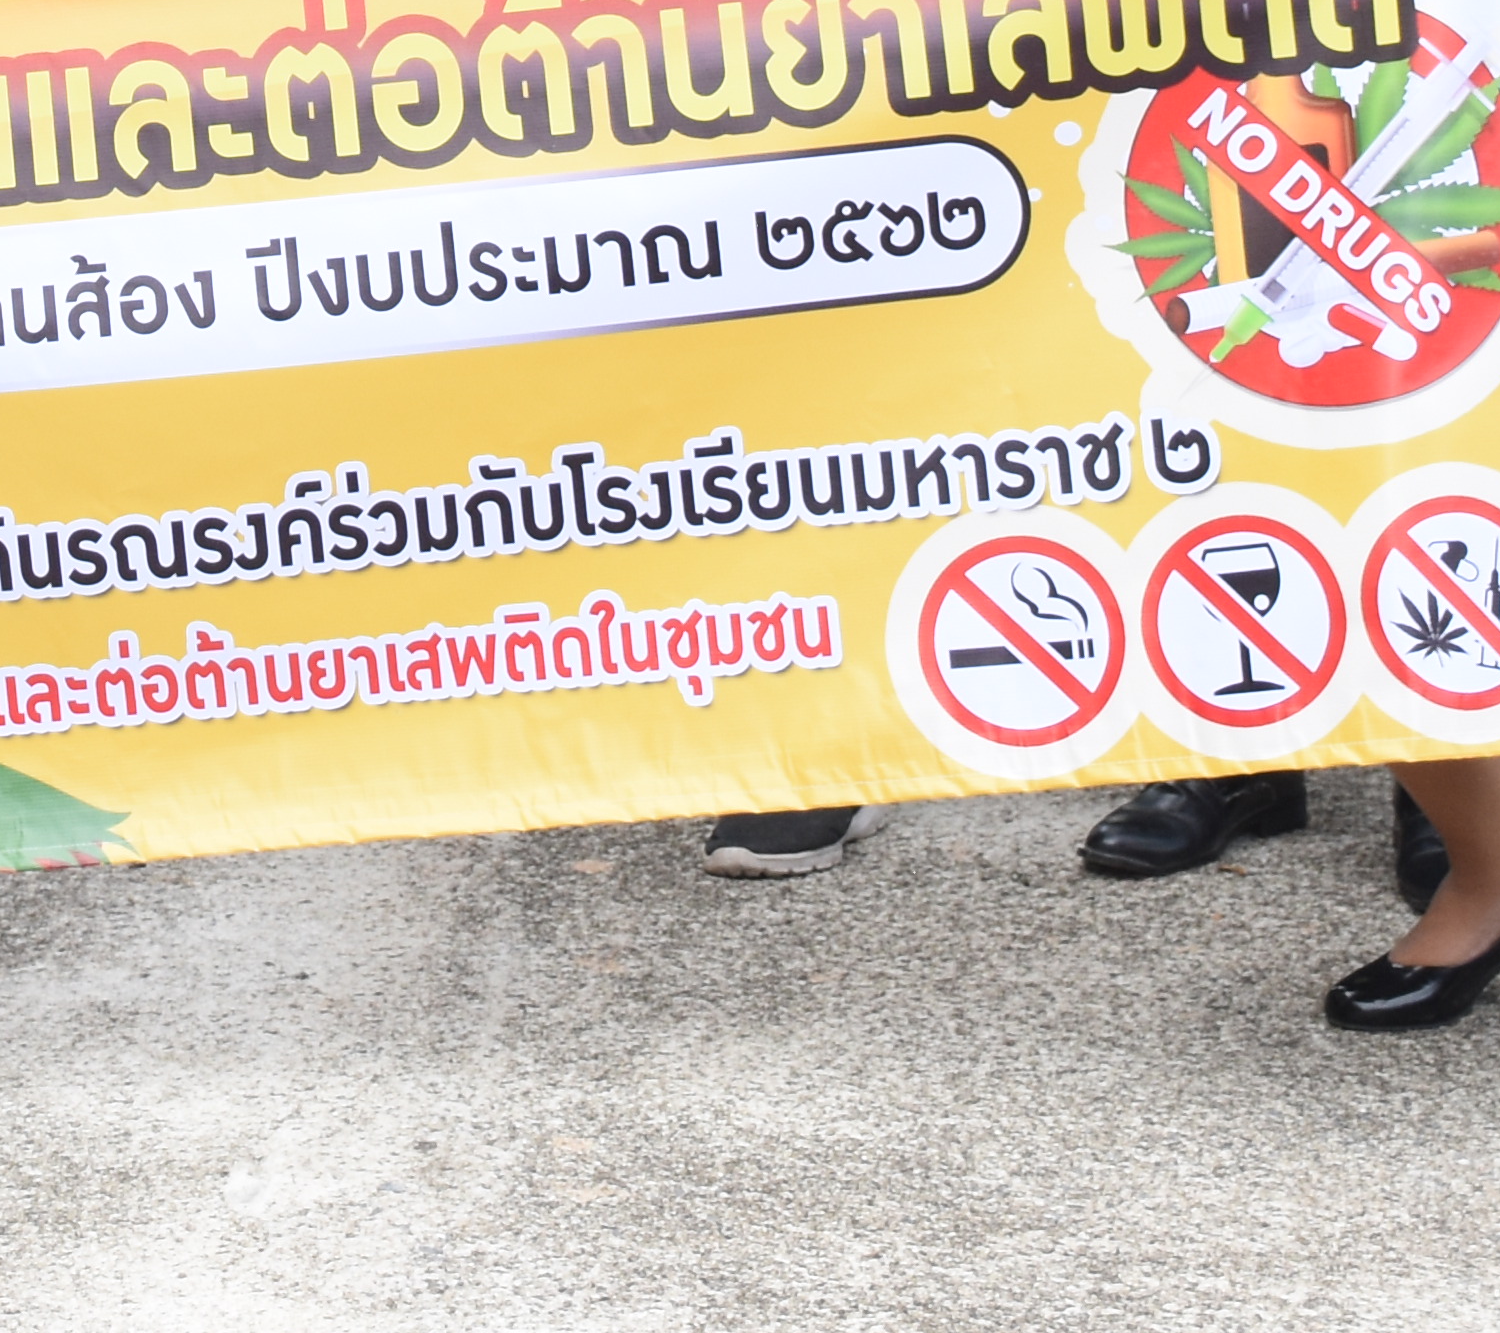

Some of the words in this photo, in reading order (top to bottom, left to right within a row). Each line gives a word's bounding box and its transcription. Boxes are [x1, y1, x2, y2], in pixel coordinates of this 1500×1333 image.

[245, 217, 723, 322] ปีงบประมาณ
[755, 191, 986, 271] ๒๕๖๒
[1187, 87, 1278, 173] NO
[1269, 159, 1451, 333] DRUGS
[1151, 417, 1212, 485] ๒
